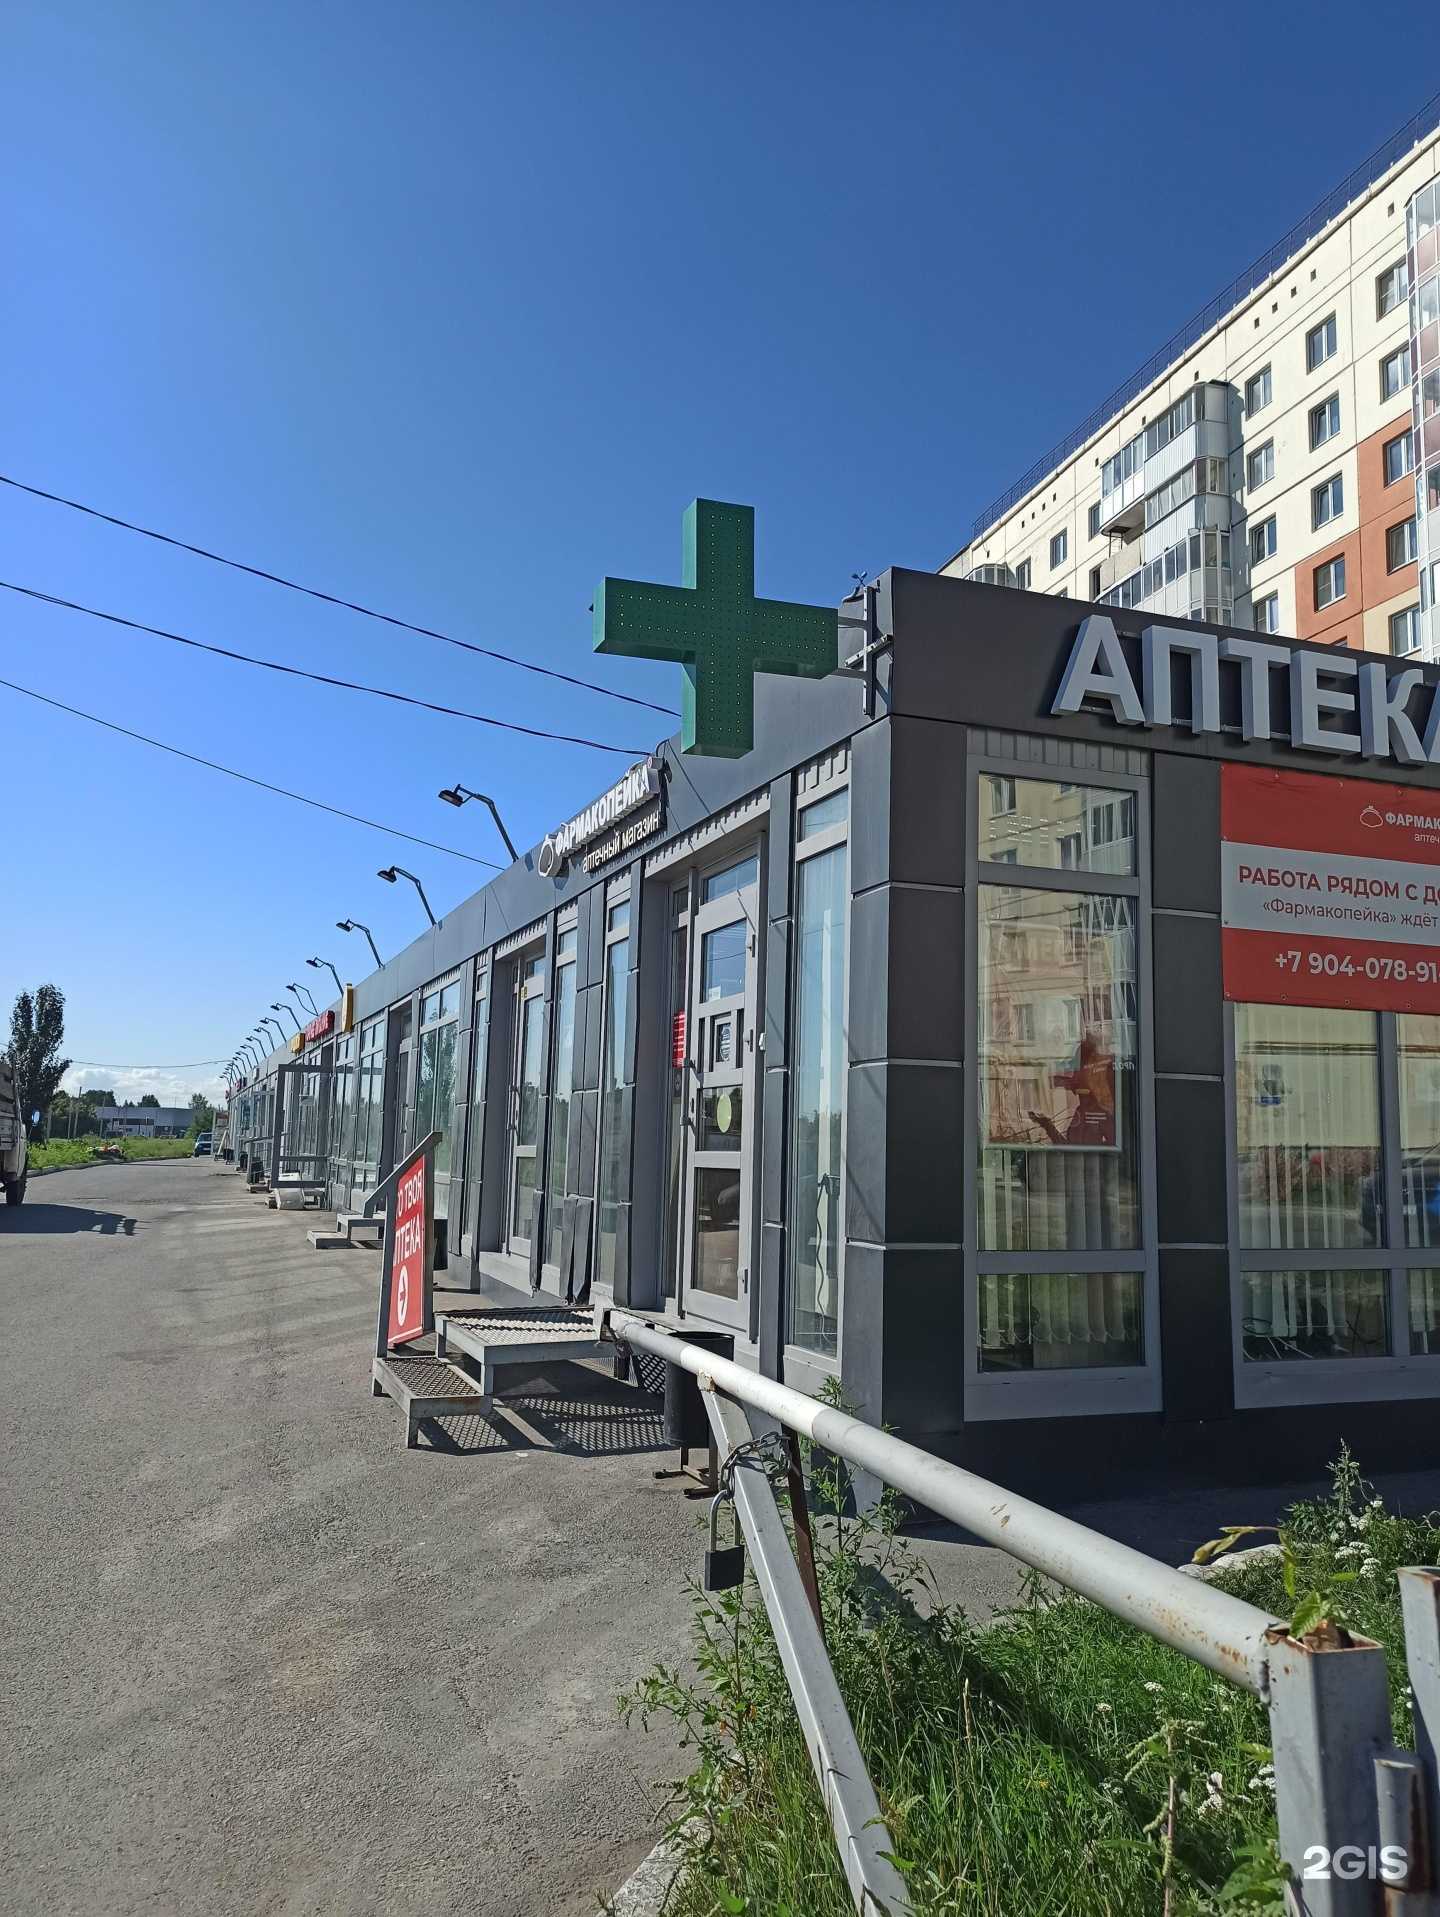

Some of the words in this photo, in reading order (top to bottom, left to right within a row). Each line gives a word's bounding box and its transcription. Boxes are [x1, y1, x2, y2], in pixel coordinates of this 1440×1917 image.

[555, 764, 651, 857] ФАРМАКОПЕЙКА
[582, 833, 620, 873] аптечный
[621, 809, 660, 848] магазин
[1239, 865, 1321, 892] РАБОТА
[1327, 875, 1399, 899] РЯДОМ
[1405, 883, 1418, 901] С
[1423, 885, 1440, 907] Д
[1263, 897, 1397, 924] «Фармакопейка»
[1400, 911, 1439, 929] ждёт
[1275, 950, 1302, 973] +7
[1308, 952, 1440, 984] 904-078-91
[404, 1168, 423, 1213] ТВОЯ
[392, 1211, 421, 1267] ПТЕКА
